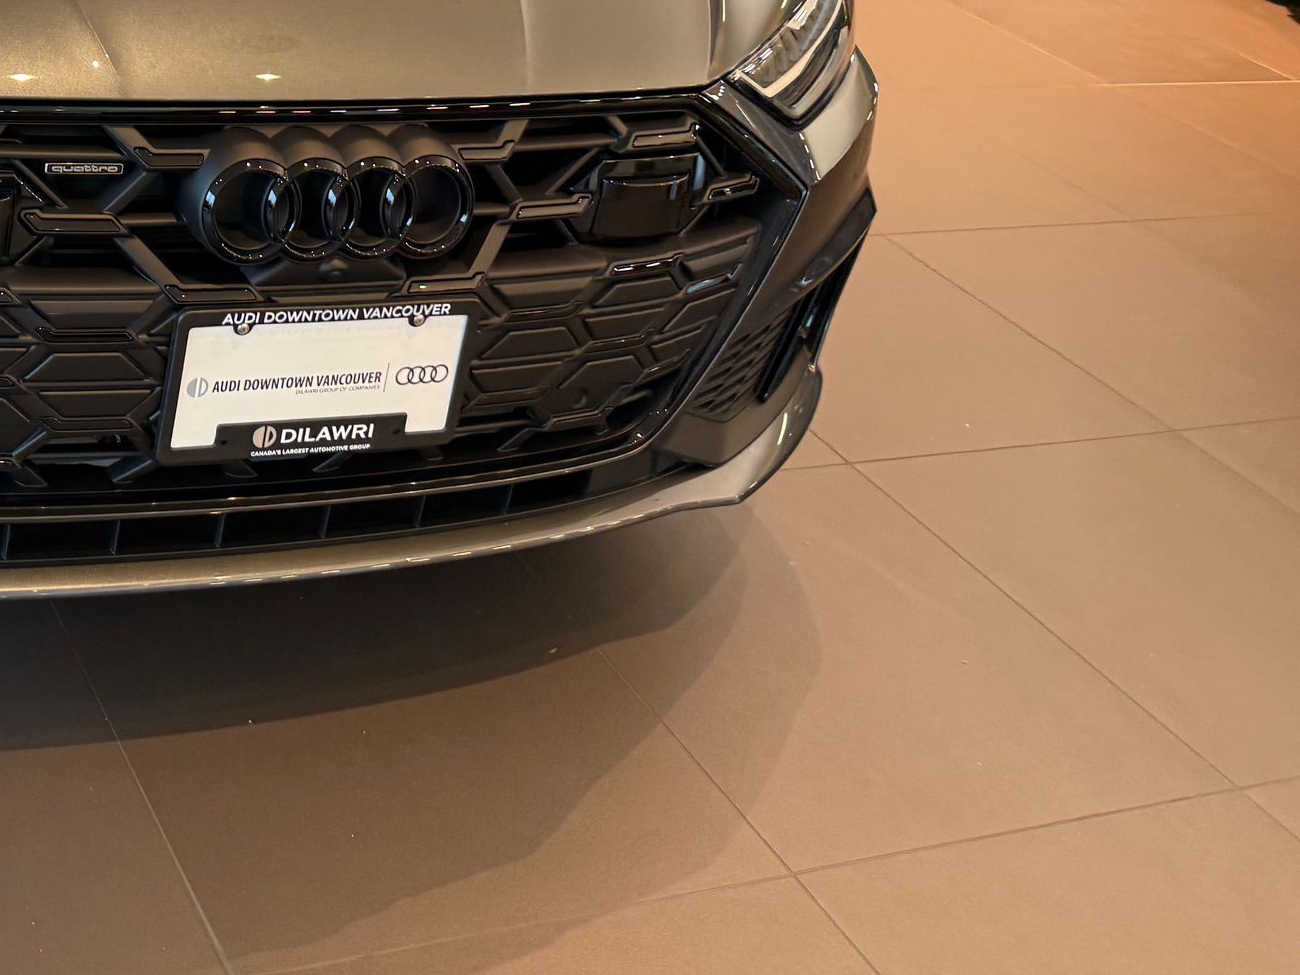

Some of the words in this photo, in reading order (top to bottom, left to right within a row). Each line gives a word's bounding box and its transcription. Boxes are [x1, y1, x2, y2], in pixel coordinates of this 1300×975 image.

[51, 165, 118, 173] quattro
[221, 311, 260, 326] AUDI
[263, 308, 359, 324] DOWNTOWN
[362, 303, 452, 320] VANCOUVER
[212, 379, 241, 394] AUDI
[243, 374, 315, 392] DOWNTOWN
[316, 371, 382, 387] VANCOUVER
[295, 388, 318, 396] DILAWRI
[319, 386, 339, 394] GROUP
[348, 384, 381, 392] COMPANIES
[280, 423, 375, 444] DILAWRI
[250, 447, 281, 457] CANADA'S
[282, 446, 309, 456] LARGEST
[309, 444, 349, 455] AUTOMOTIVE
[349, 443, 371, 452] GROUP
